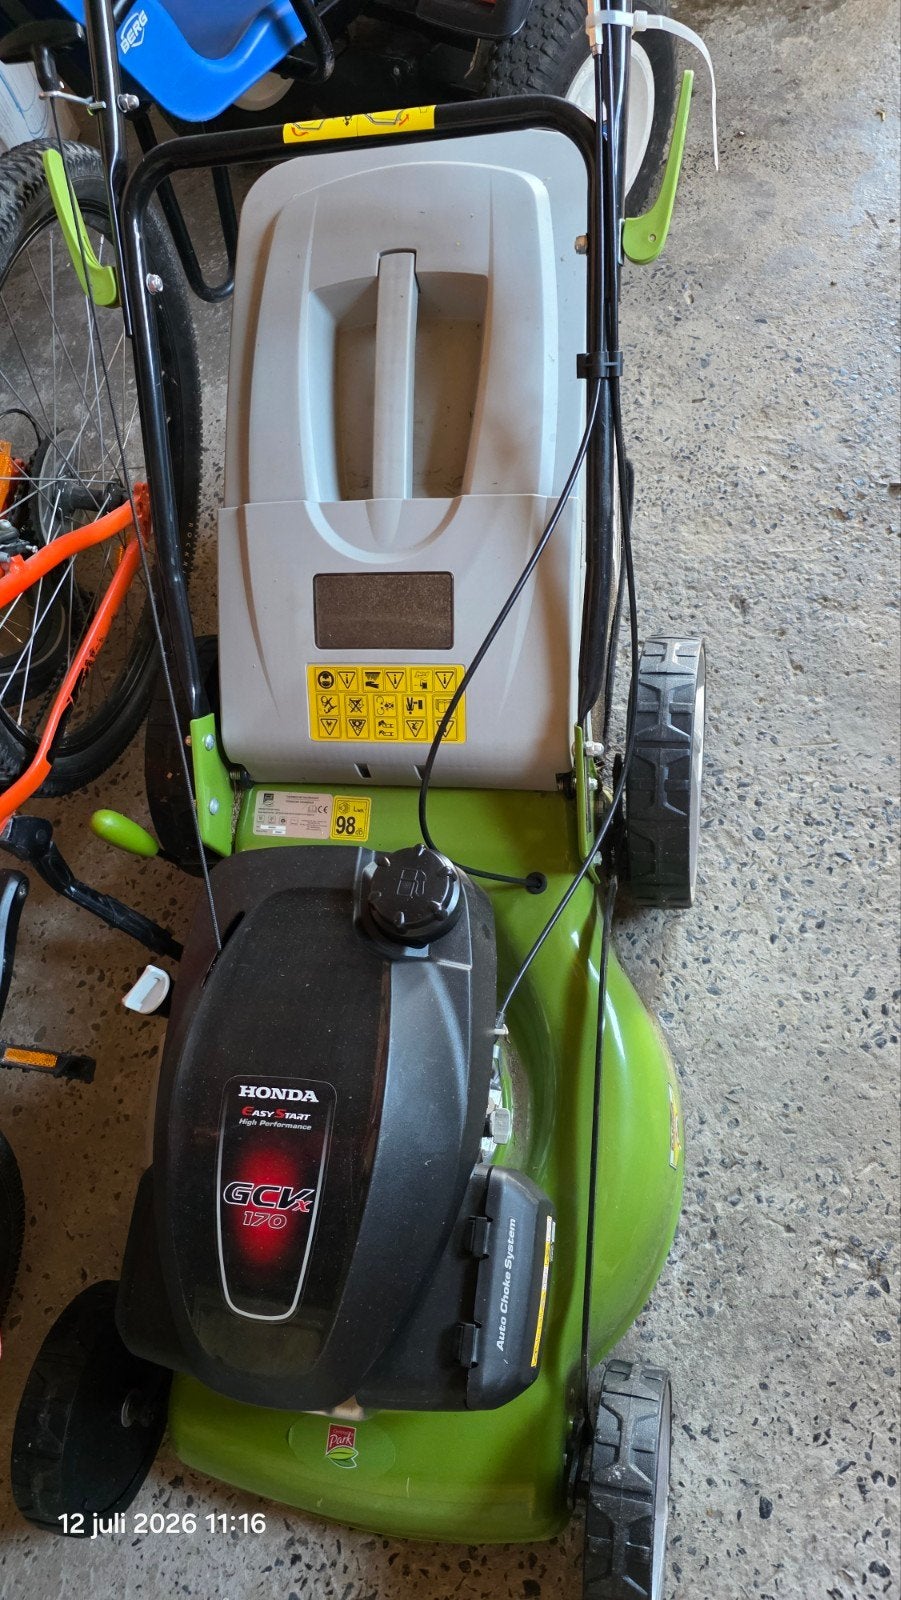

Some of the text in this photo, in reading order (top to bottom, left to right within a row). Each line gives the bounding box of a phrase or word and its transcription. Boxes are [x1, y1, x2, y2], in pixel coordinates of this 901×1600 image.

[120, 9, 148, 54] BERG
[336, 815, 356, 835] 98
[238, 1085, 319, 1103] HONDA
[238, 1118, 312, 1131] High Performance
[242, 1210, 287, 1229] 170
[496, 1218, 516, 1351] Auto Choke System
[329, 1431, 353, 1448] Park
